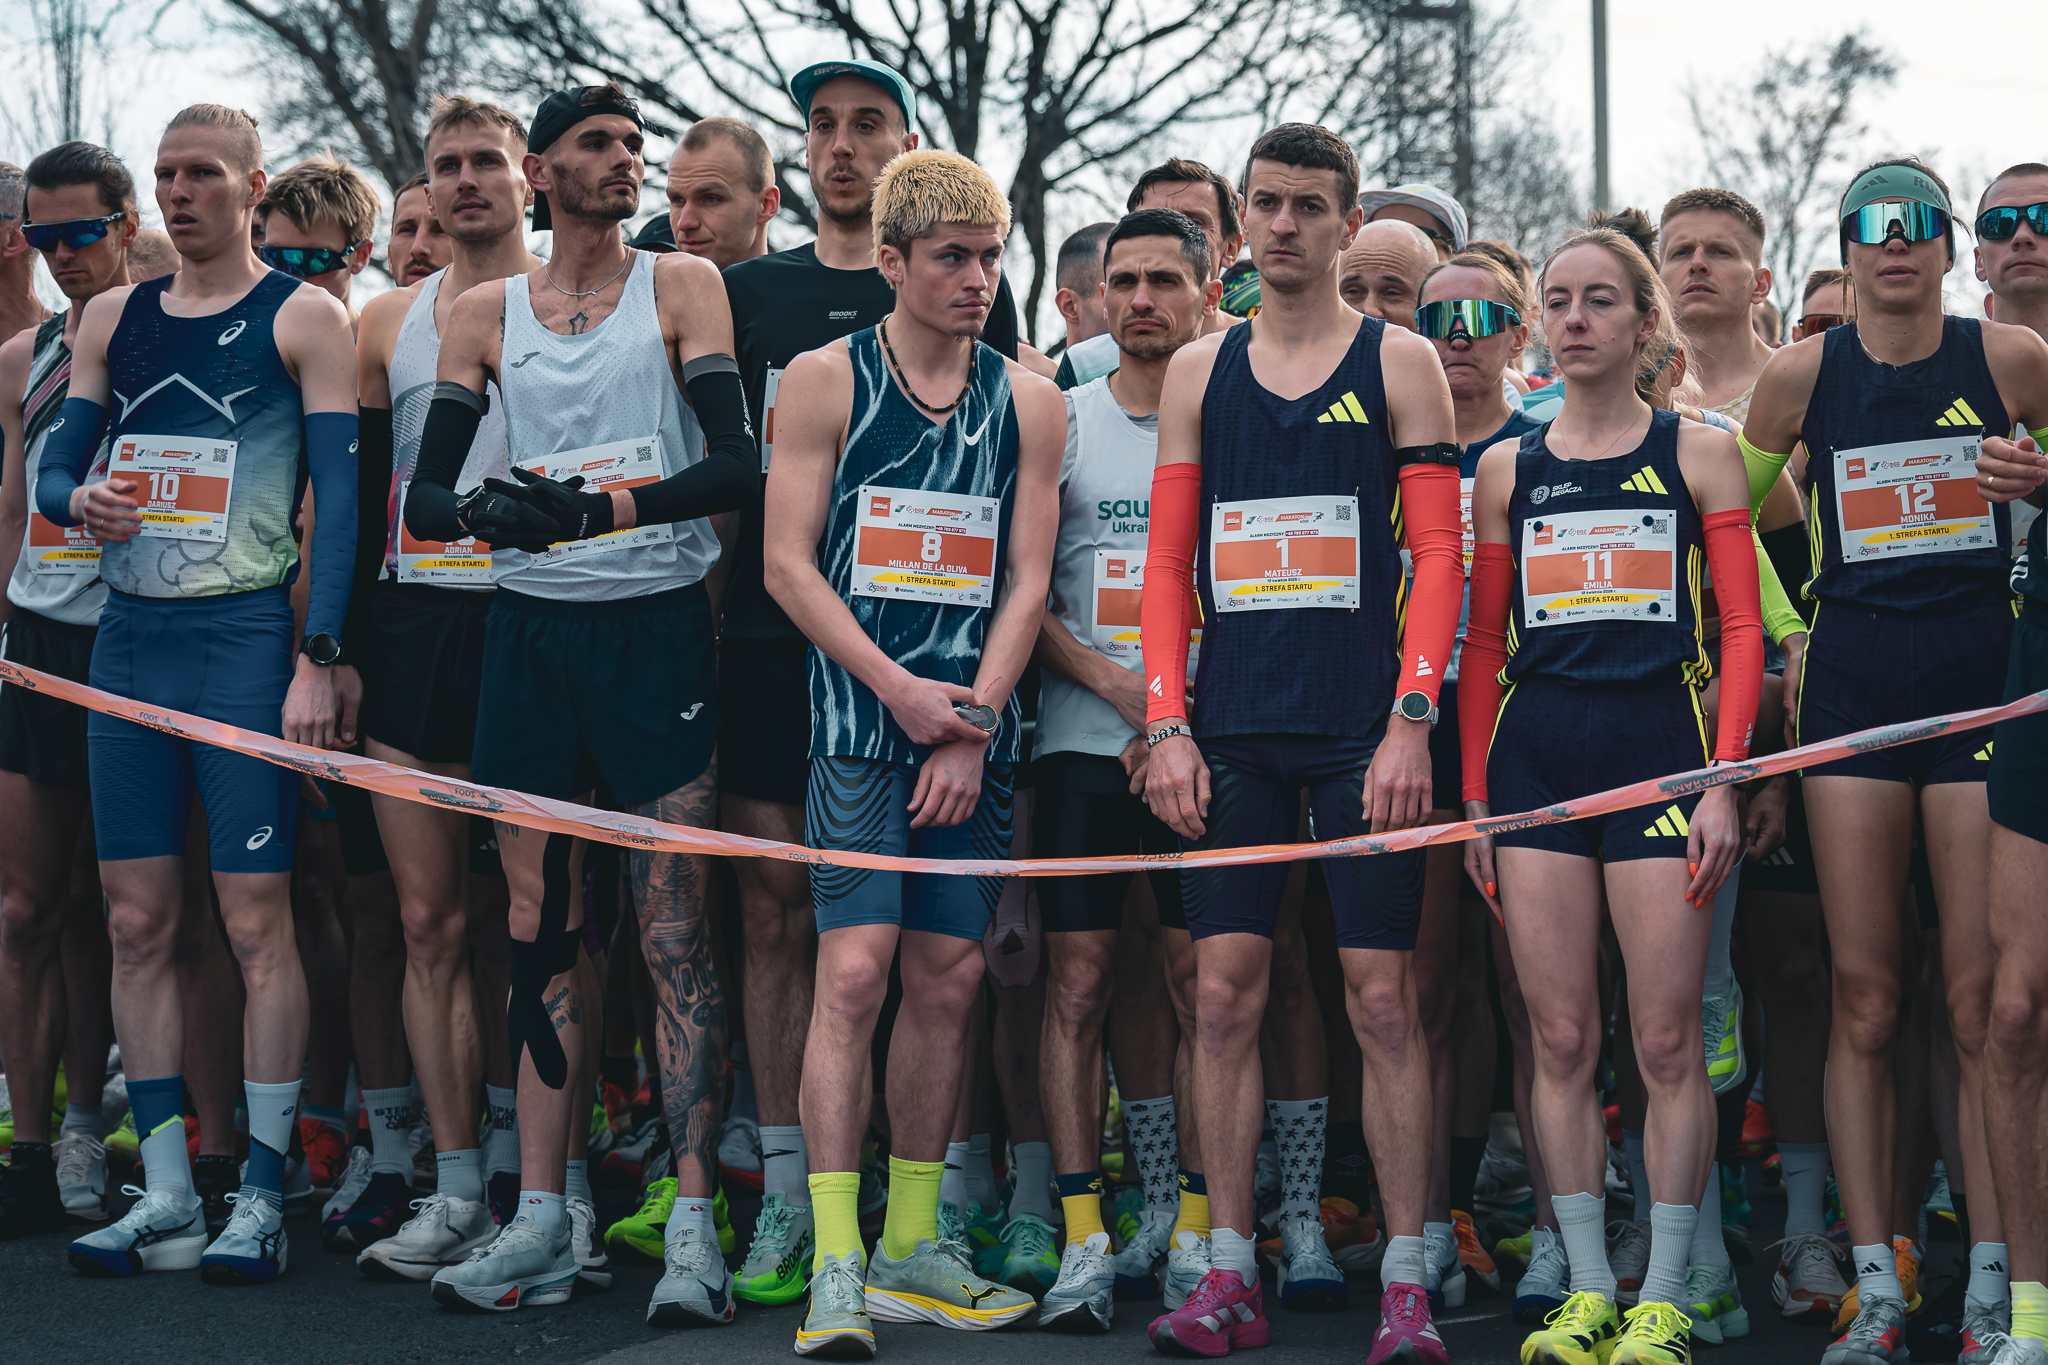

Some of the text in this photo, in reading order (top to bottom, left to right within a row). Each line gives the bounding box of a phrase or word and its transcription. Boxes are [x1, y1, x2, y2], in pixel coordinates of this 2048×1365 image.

[149, 472, 180, 501] 10
[1895, 482, 1937, 514] 12
[147, 500, 176, 509] DARIUSZ
[1097, 499, 1150, 521] sau
[142, 514, 184, 523] STREFA STARTU
[932, 509, 956, 517] MARATON
[1900, 513, 1936, 524] MONIKA
[1112, 522, 1148, 534] Ukrai
[1896, 530, 1922, 539] STREFA
[1923, 527, 1949, 536] STARTU
[68, 539, 96, 547] MARCIN
[921, 532, 943, 562] 8
[1276, 538, 1289, 568] 1
[888, 559, 968, 574] MILLAN DE LA OLIVA
[1581, 550, 1612, 581] 11
[1264, 568, 1302, 578] MATEUSZ
[906, 577, 931, 585] STREFA
[932, 578, 956, 587] STARTU
[1583, 581, 1613, 590] EMILIA
[1261, 584, 1286, 592] STREFA
[1576, 596, 1601, 605] STREFA
[776, 1229, 809, 1281] BROOKS
